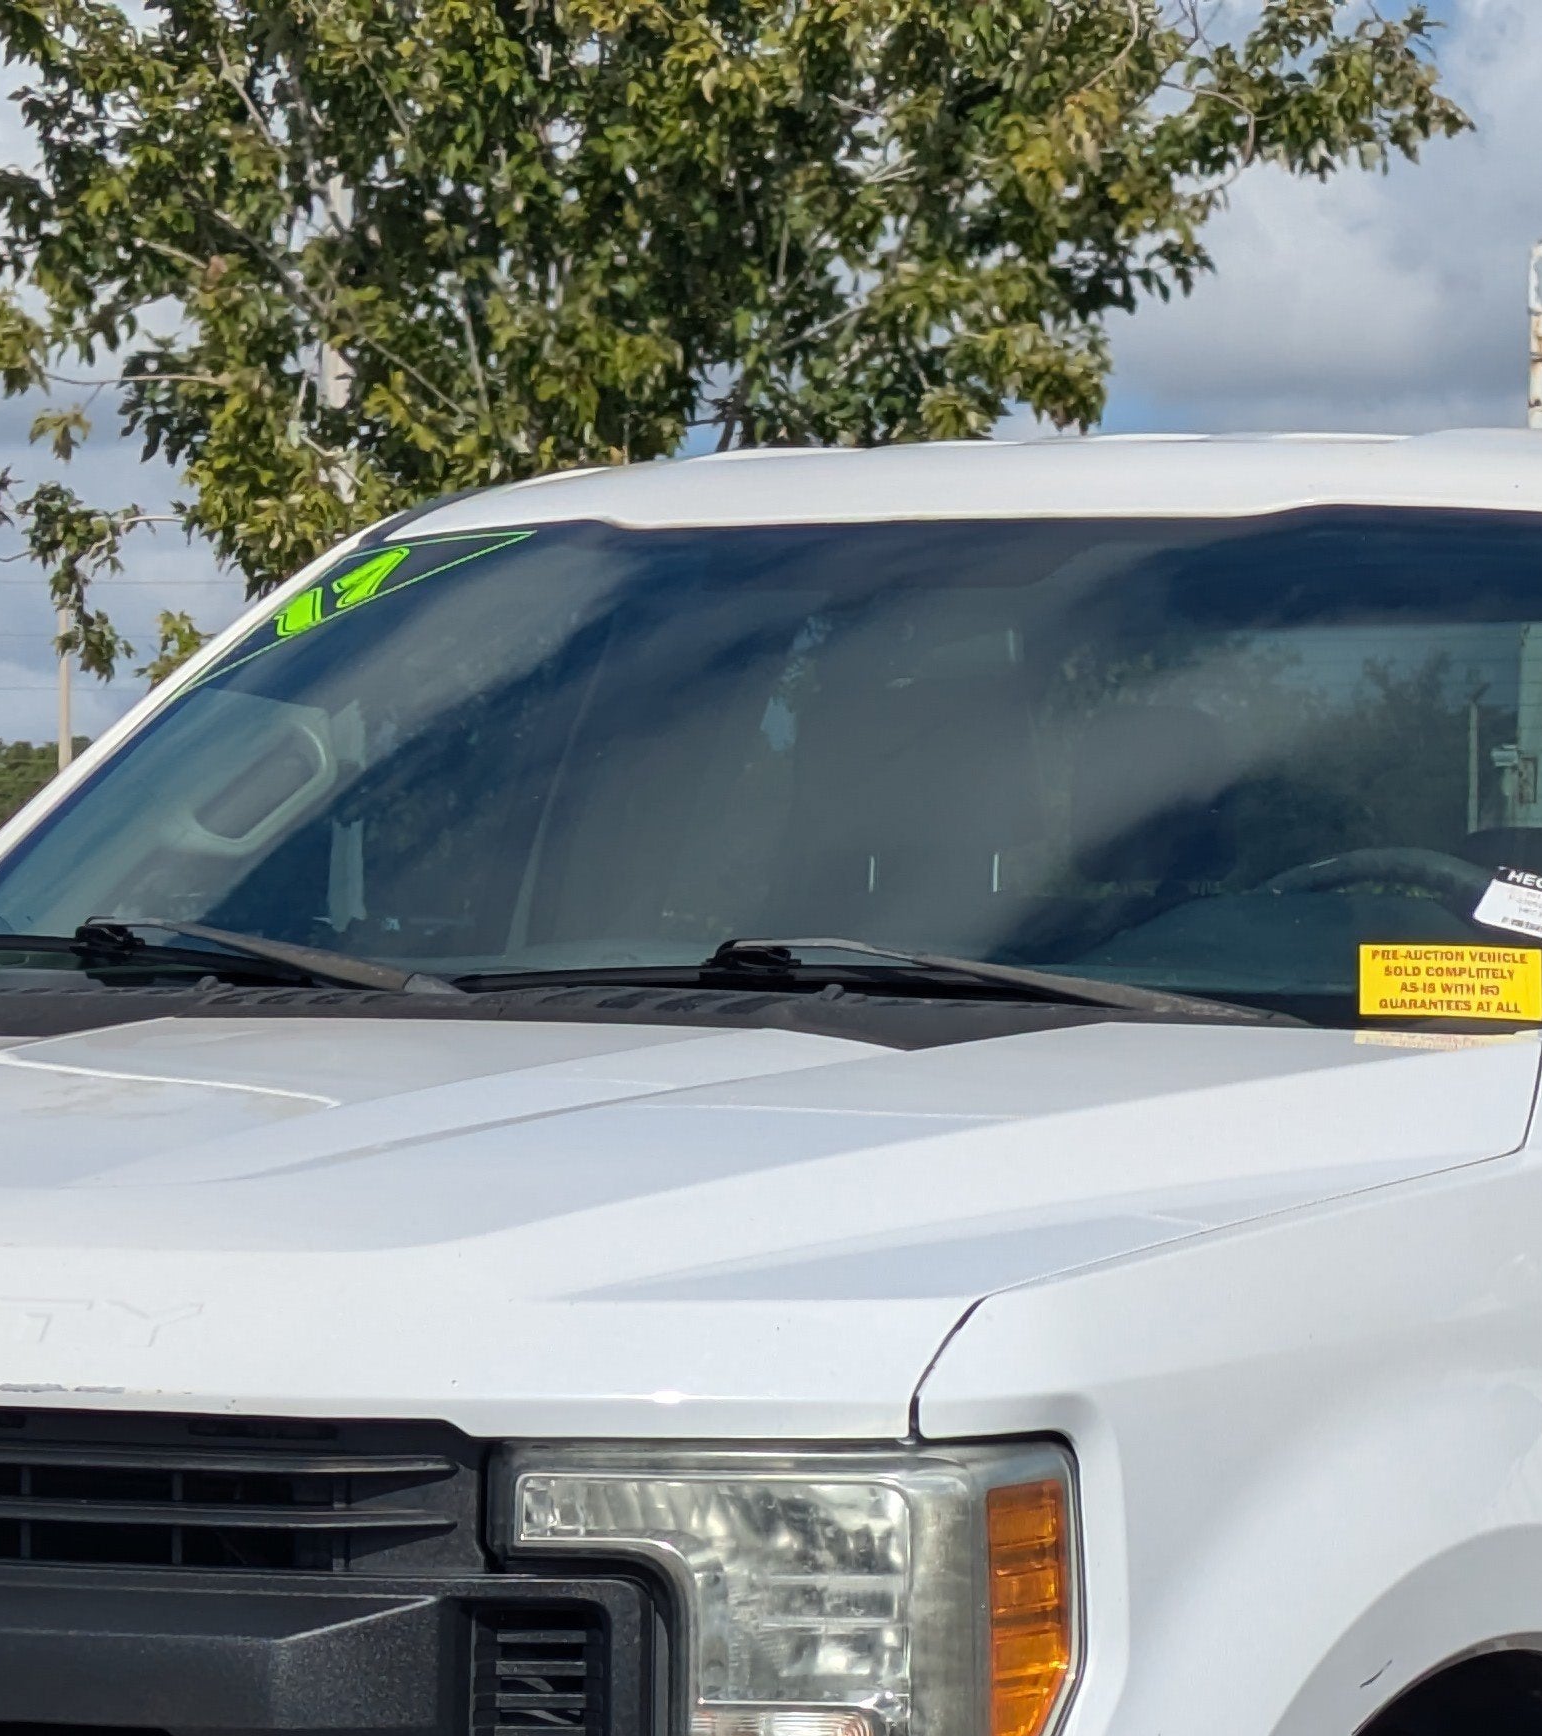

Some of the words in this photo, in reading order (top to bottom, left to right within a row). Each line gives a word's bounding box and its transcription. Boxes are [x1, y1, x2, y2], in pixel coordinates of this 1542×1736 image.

[1469, 951, 1528, 964] VEHICLE
[1384, 965, 1421, 977] SOLD
[1425, 966, 1515, 980] COMPLETELY
[1440, 983, 1475, 996] WITH
[1480, 984, 1500, 996] NO
[1378, 998, 1472, 1012] GUARANTEES
[1476, 1001, 1492, 1013] AT
[1495, 1001, 1522, 1014] ALL
